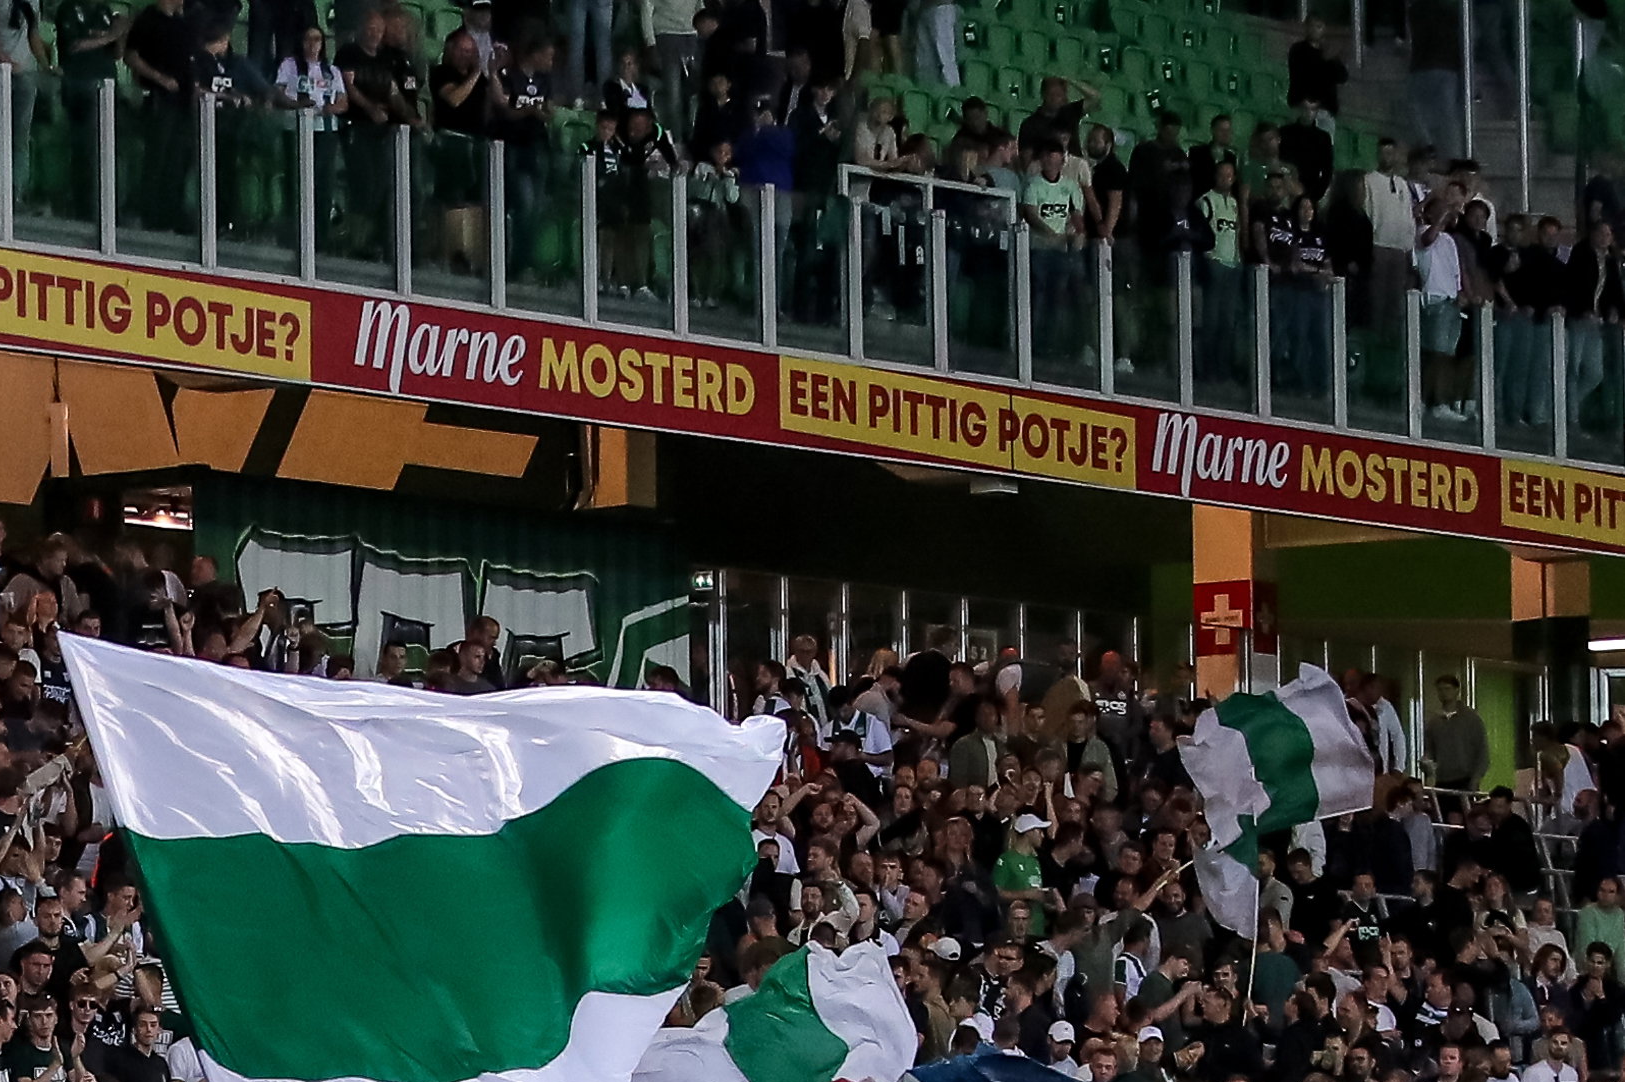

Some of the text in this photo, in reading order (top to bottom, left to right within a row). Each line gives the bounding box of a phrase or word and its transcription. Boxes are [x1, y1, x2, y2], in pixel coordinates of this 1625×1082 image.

[146, 297, 301, 361] POTJE?
[354, 300, 756, 415] Marne MOSTERD
[789, 370, 1128, 472] EEN PITTIG POTJE?
[1152, 413, 1479, 513] Marne MOSTERD
[1509, 471, 1625, 530] EEN PIT
